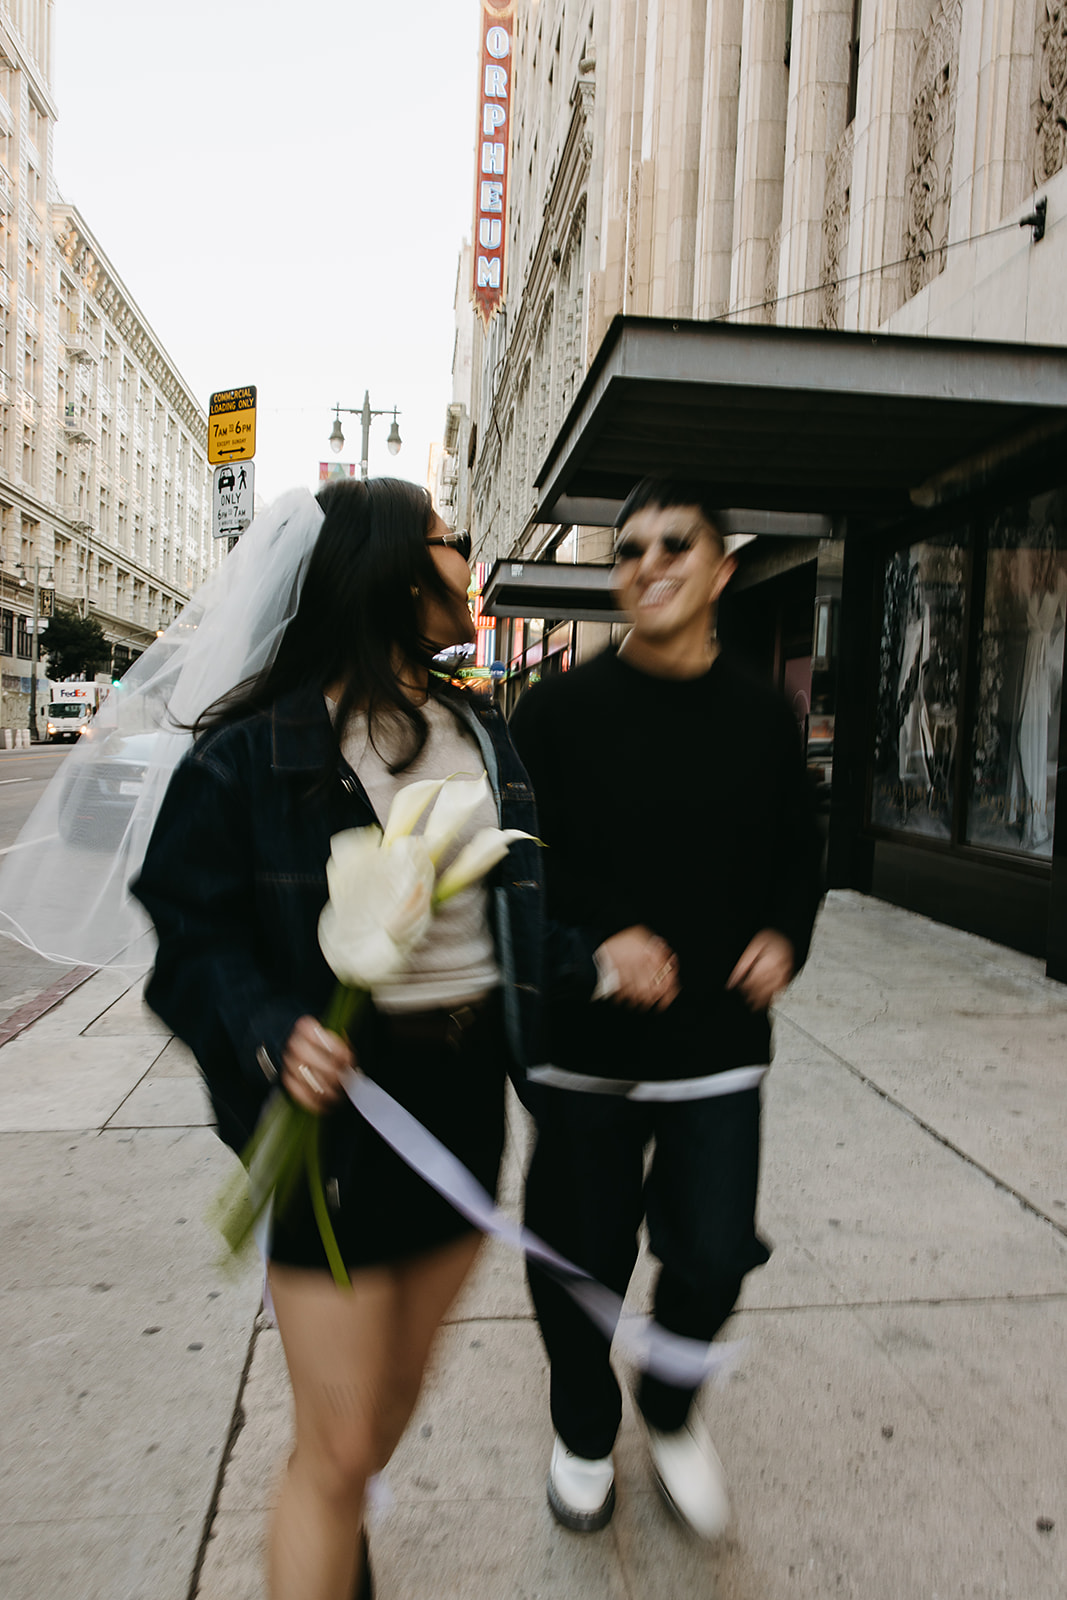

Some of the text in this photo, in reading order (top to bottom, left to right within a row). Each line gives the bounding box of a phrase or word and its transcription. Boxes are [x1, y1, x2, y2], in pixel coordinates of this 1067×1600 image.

[476, 26, 510, 288] ORPHEUM
[210, 397, 254, 414] LOADING ONLY
[221, 492, 241, 506] ONLY
[60, 689, 87, 697] FedEx
